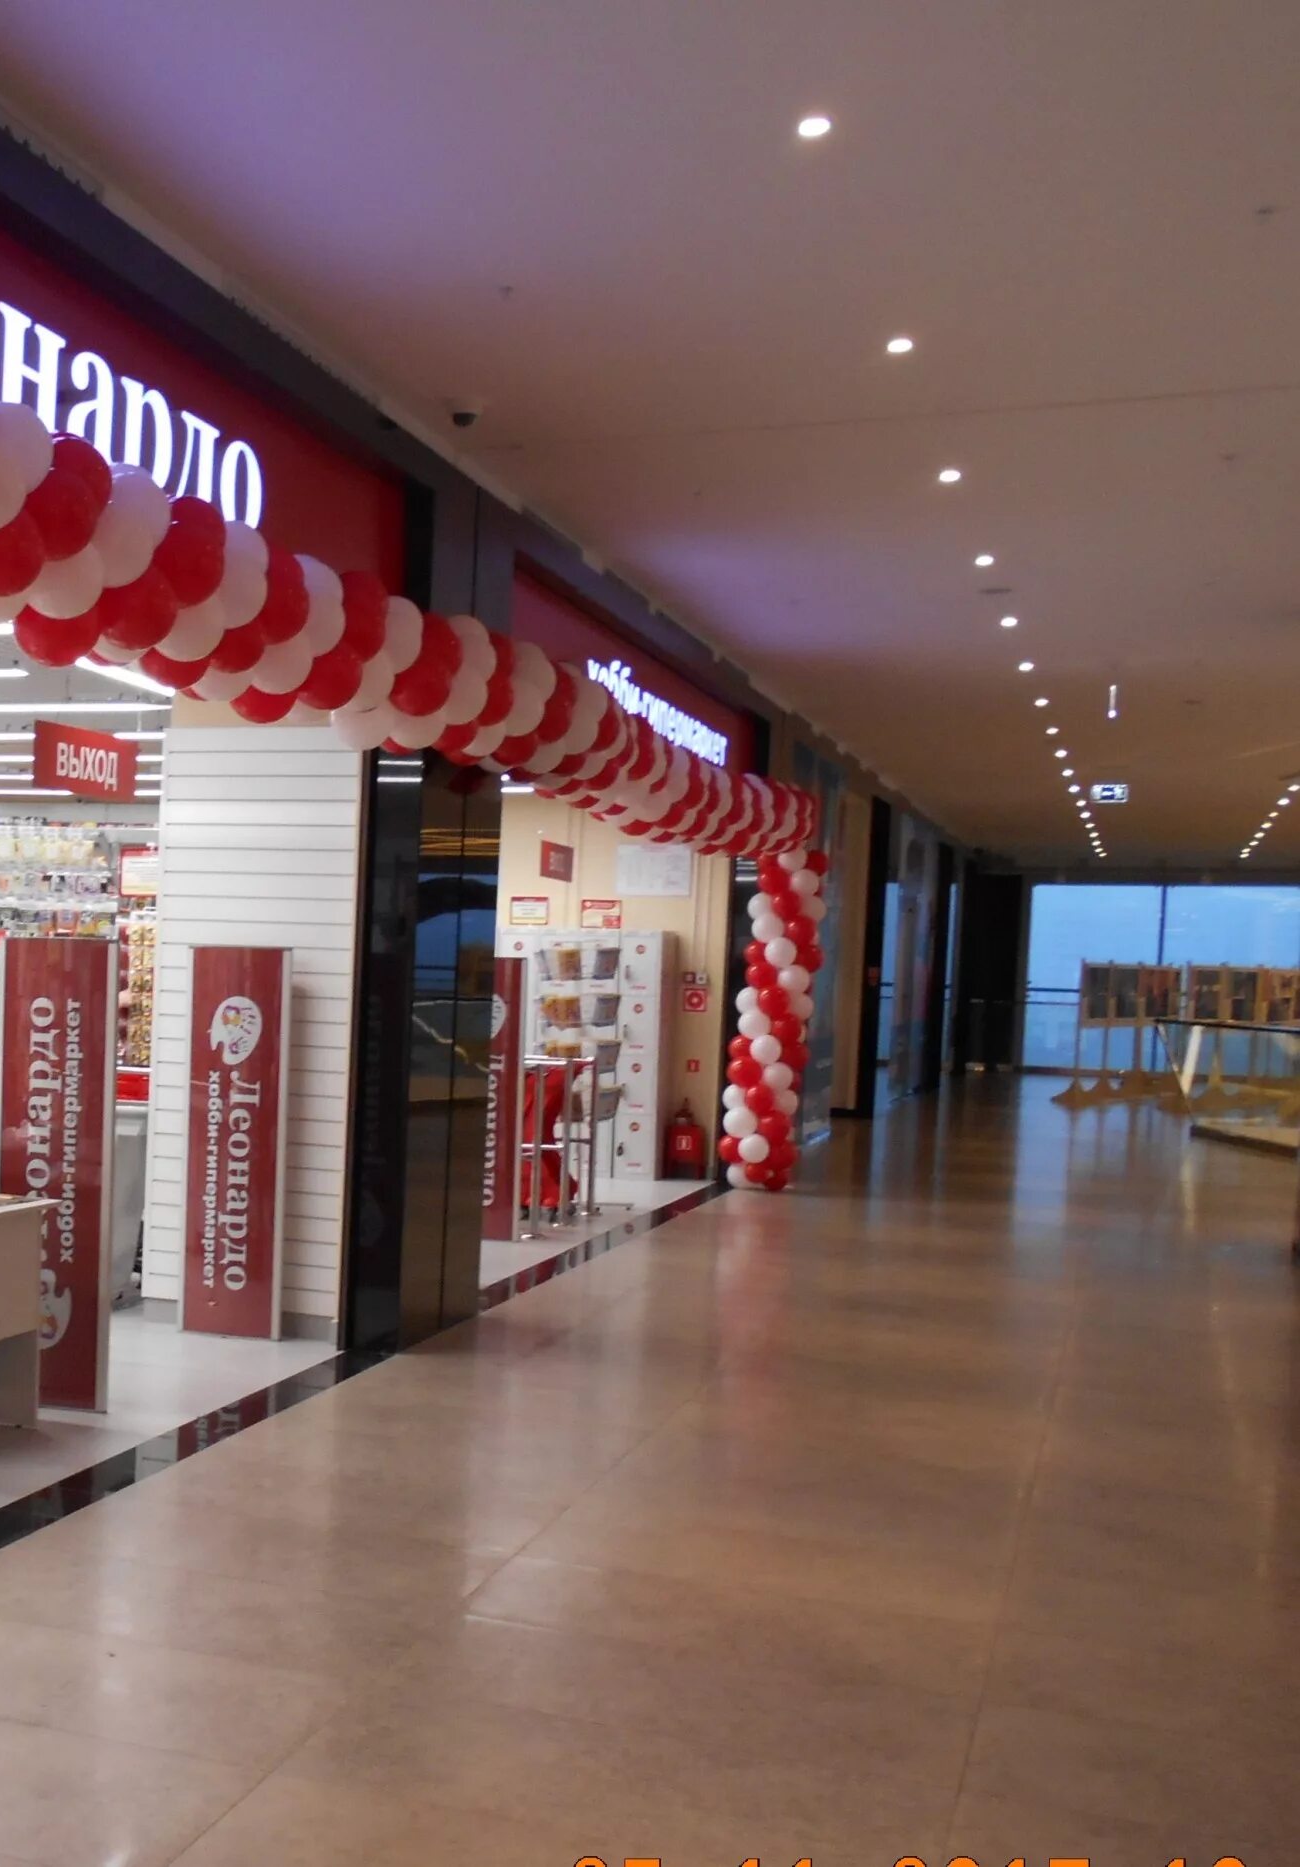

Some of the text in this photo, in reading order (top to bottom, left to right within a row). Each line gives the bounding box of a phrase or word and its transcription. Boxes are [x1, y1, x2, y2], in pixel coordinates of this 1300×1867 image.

[56, 741, 119, 792] ВЫХОД
[56, 998, 84, 1264] хобби-гипермаркет
[203, 1069, 224, 1289] хобби-гипермаркет
[218, 1070, 261, 1292] Леонардо
